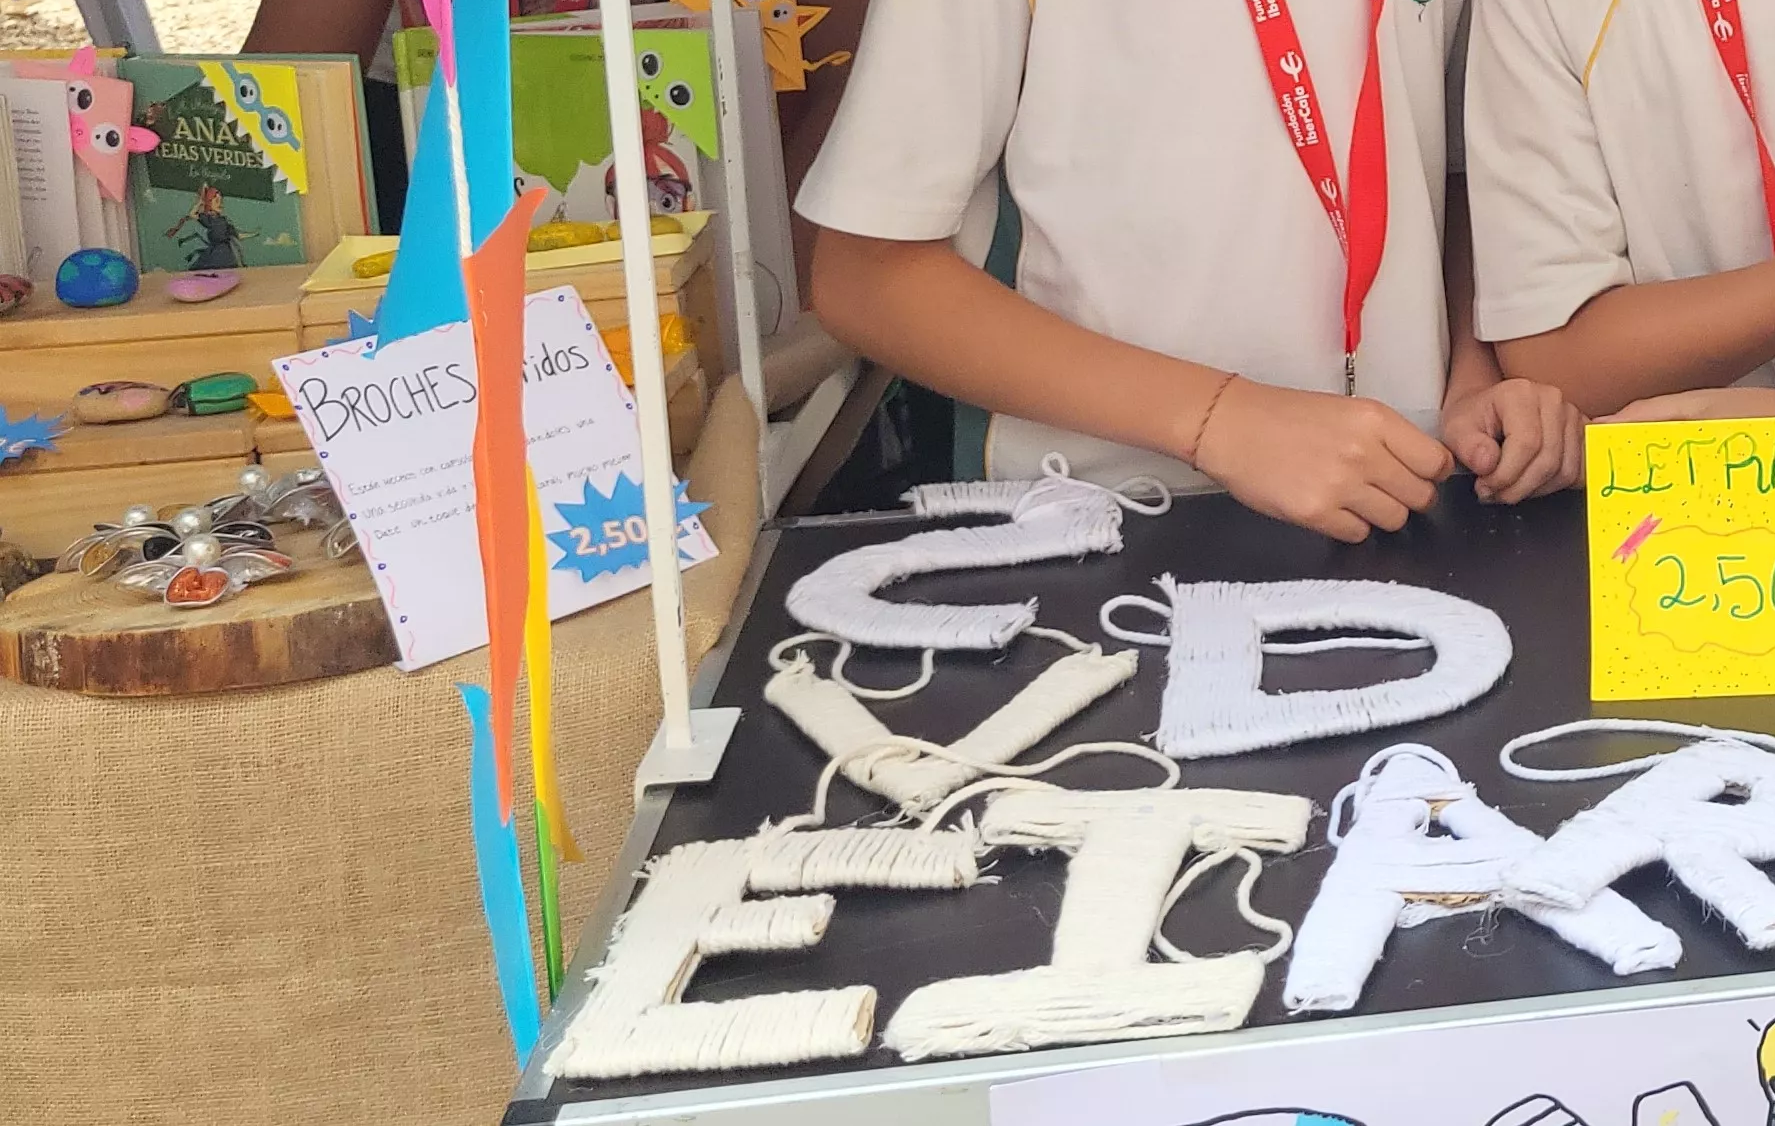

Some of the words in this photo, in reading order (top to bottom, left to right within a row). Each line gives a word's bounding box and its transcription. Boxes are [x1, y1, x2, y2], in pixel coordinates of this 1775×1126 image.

[173, 116, 239, 147] ANA
[1281, 93, 1306, 148] Fundación
[299, 362, 477, 442] BROCHES
[569, 515, 648, 556] 2,50
